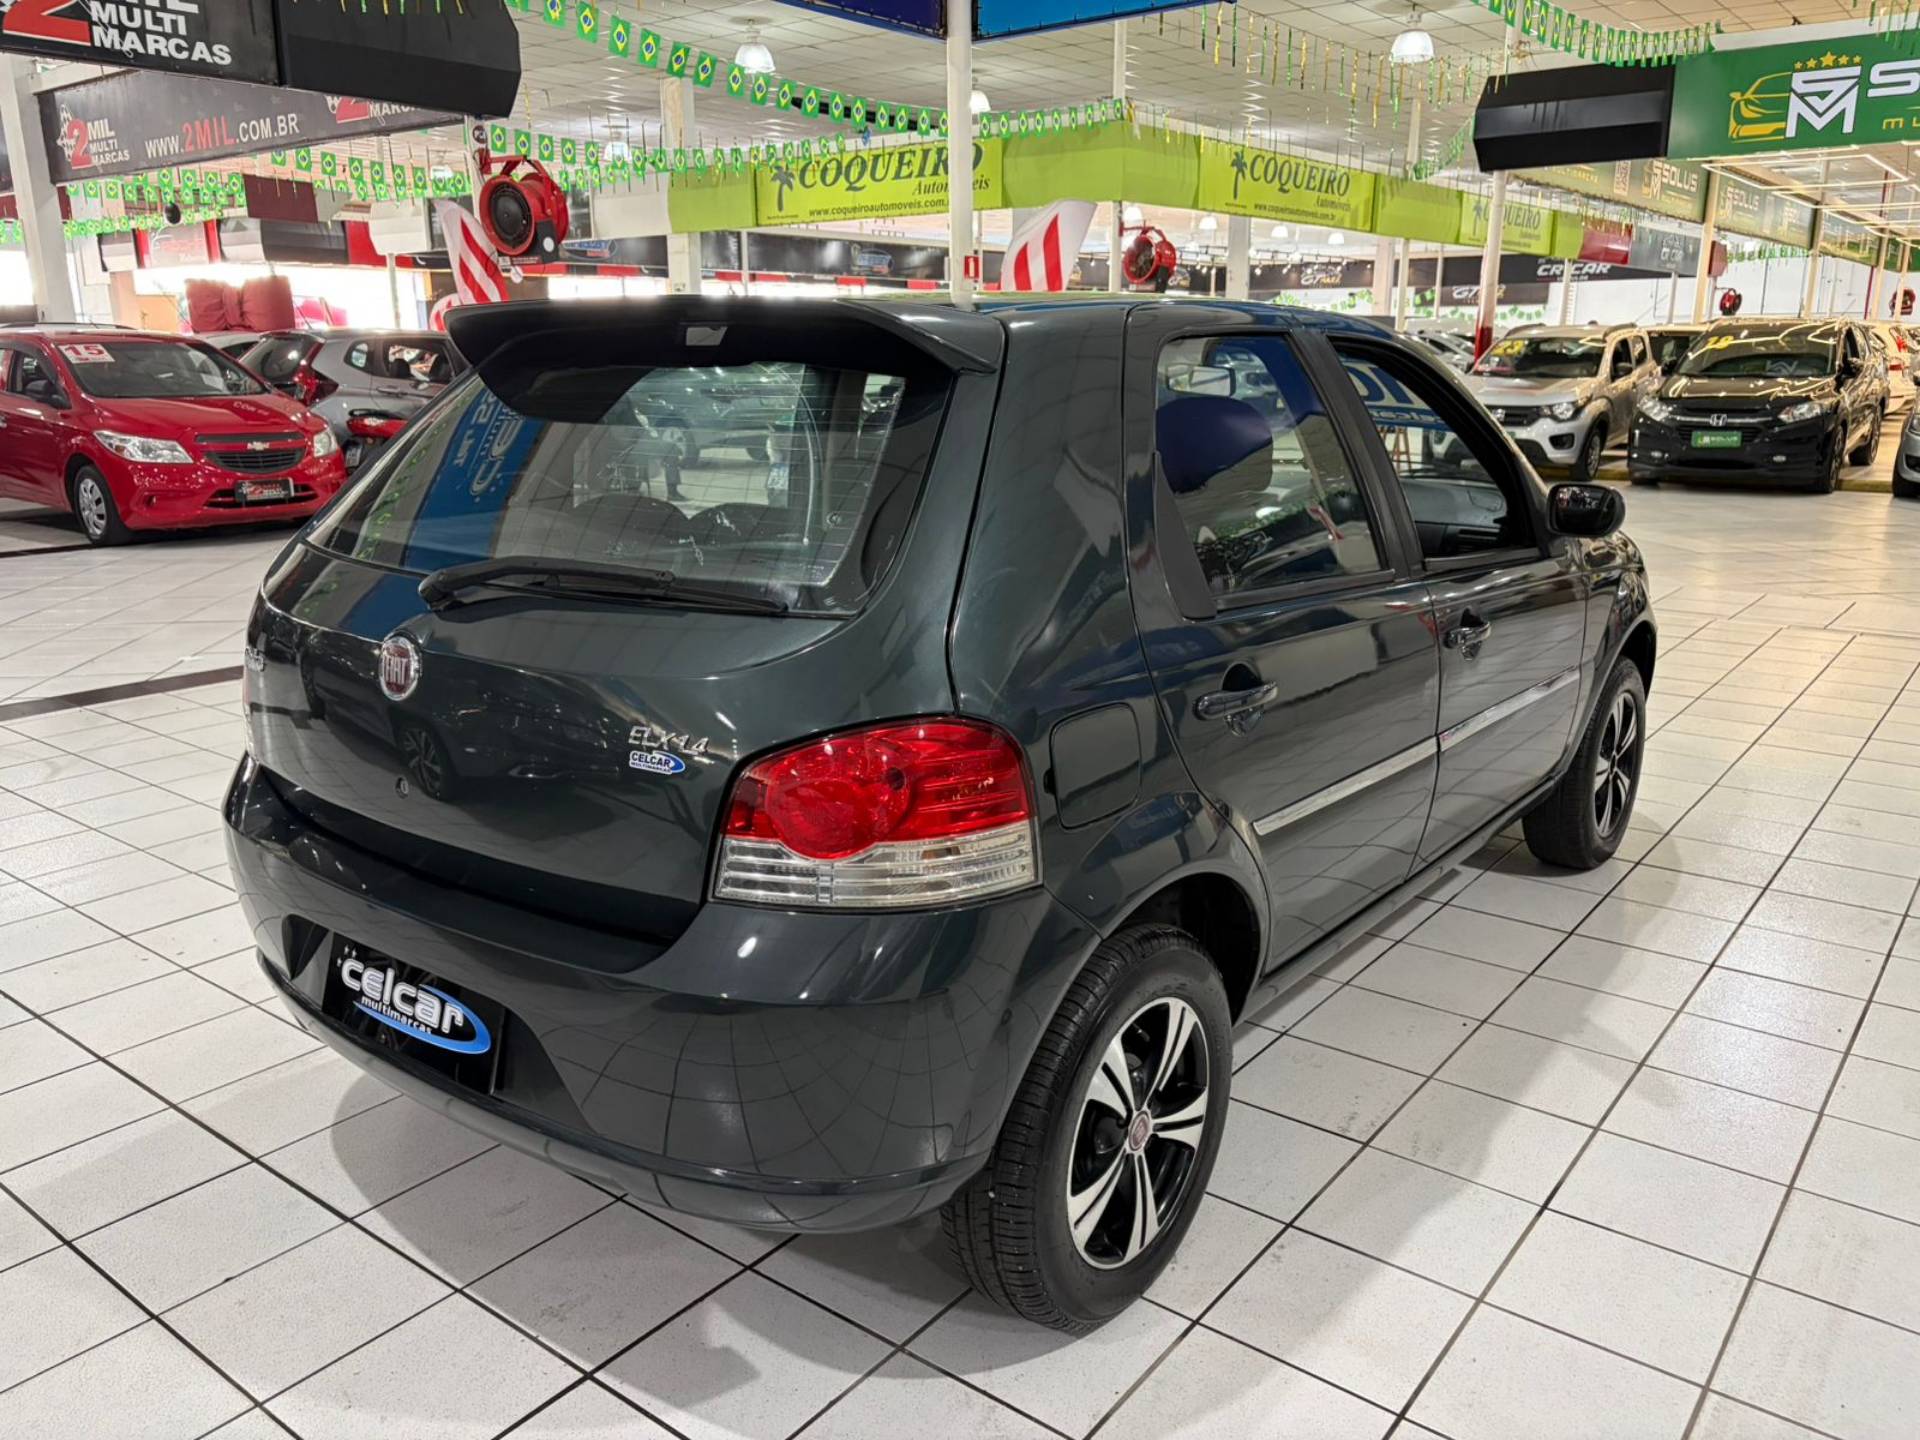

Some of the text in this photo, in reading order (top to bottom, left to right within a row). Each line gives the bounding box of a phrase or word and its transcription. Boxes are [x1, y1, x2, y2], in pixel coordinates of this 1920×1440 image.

[92, 1, 187, 35] MULTI
[92, 26, 232, 65] MARCAS
[87, 118, 115, 140] MIL
[144, 113, 300, 159] WWW.2MIL.COM.BR
[1250, 154, 1350, 197] COQUEIRO
[1662, 163, 1698, 193] SOLUS
[64, 344, 104, 357] 15
[386, 655, 409, 685] FIAT
[631, 752, 671, 768] CELCAR
[341, 958, 464, 1034] celcar
[361, 996, 433, 1035] multimarcas
